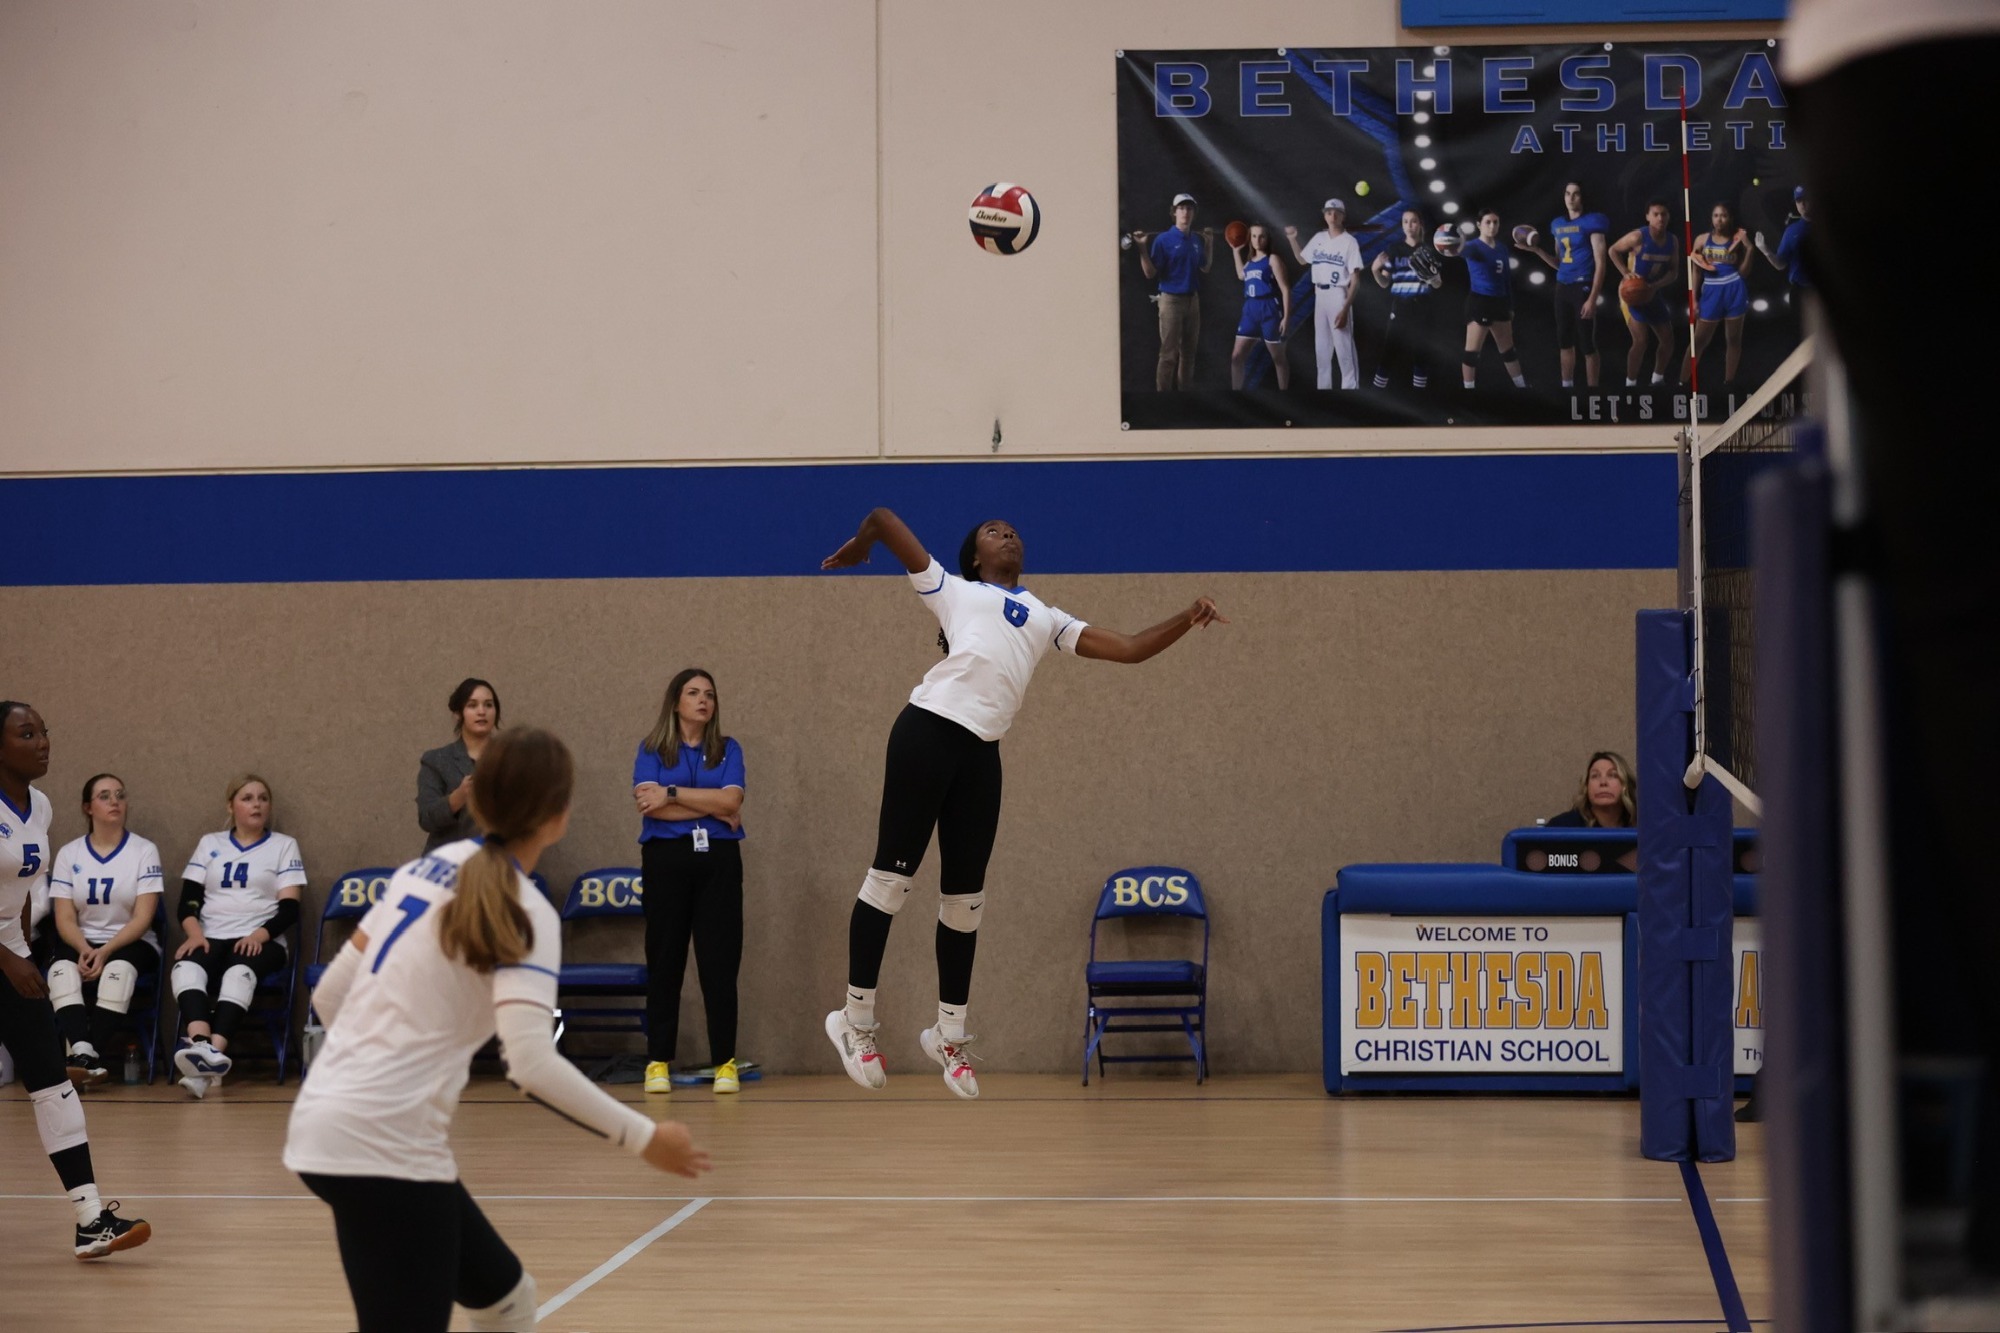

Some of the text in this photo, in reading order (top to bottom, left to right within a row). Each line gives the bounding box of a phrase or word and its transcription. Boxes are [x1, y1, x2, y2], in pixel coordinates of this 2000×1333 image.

[1154, 52, 1789, 118] BETHESDA
[1510, 120, 1786, 153] ATHLETI
[1561, 237, 1573, 264] 1
[1330, 271, 1340, 285] 9
[1571, 395, 1653, 420] LET'S
[1673, 394, 1708, 419] GO
[18, 843, 41, 878] 5
[1548, 854, 1578, 868] BONUS
[221, 862, 249, 888] 14
[87, 878, 114, 905] 17
[580, 877, 644, 908] BCS
[1113, 876, 1189, 908] BCS
[370, 894, 431, 975] 7
[1416, 927, 1549, 942] WELCOME TO
[1355, 951, 1608, 1030] BETHESDA
[1355, 1040, 1609, 1062] CHRISTIAN SCHOOL
